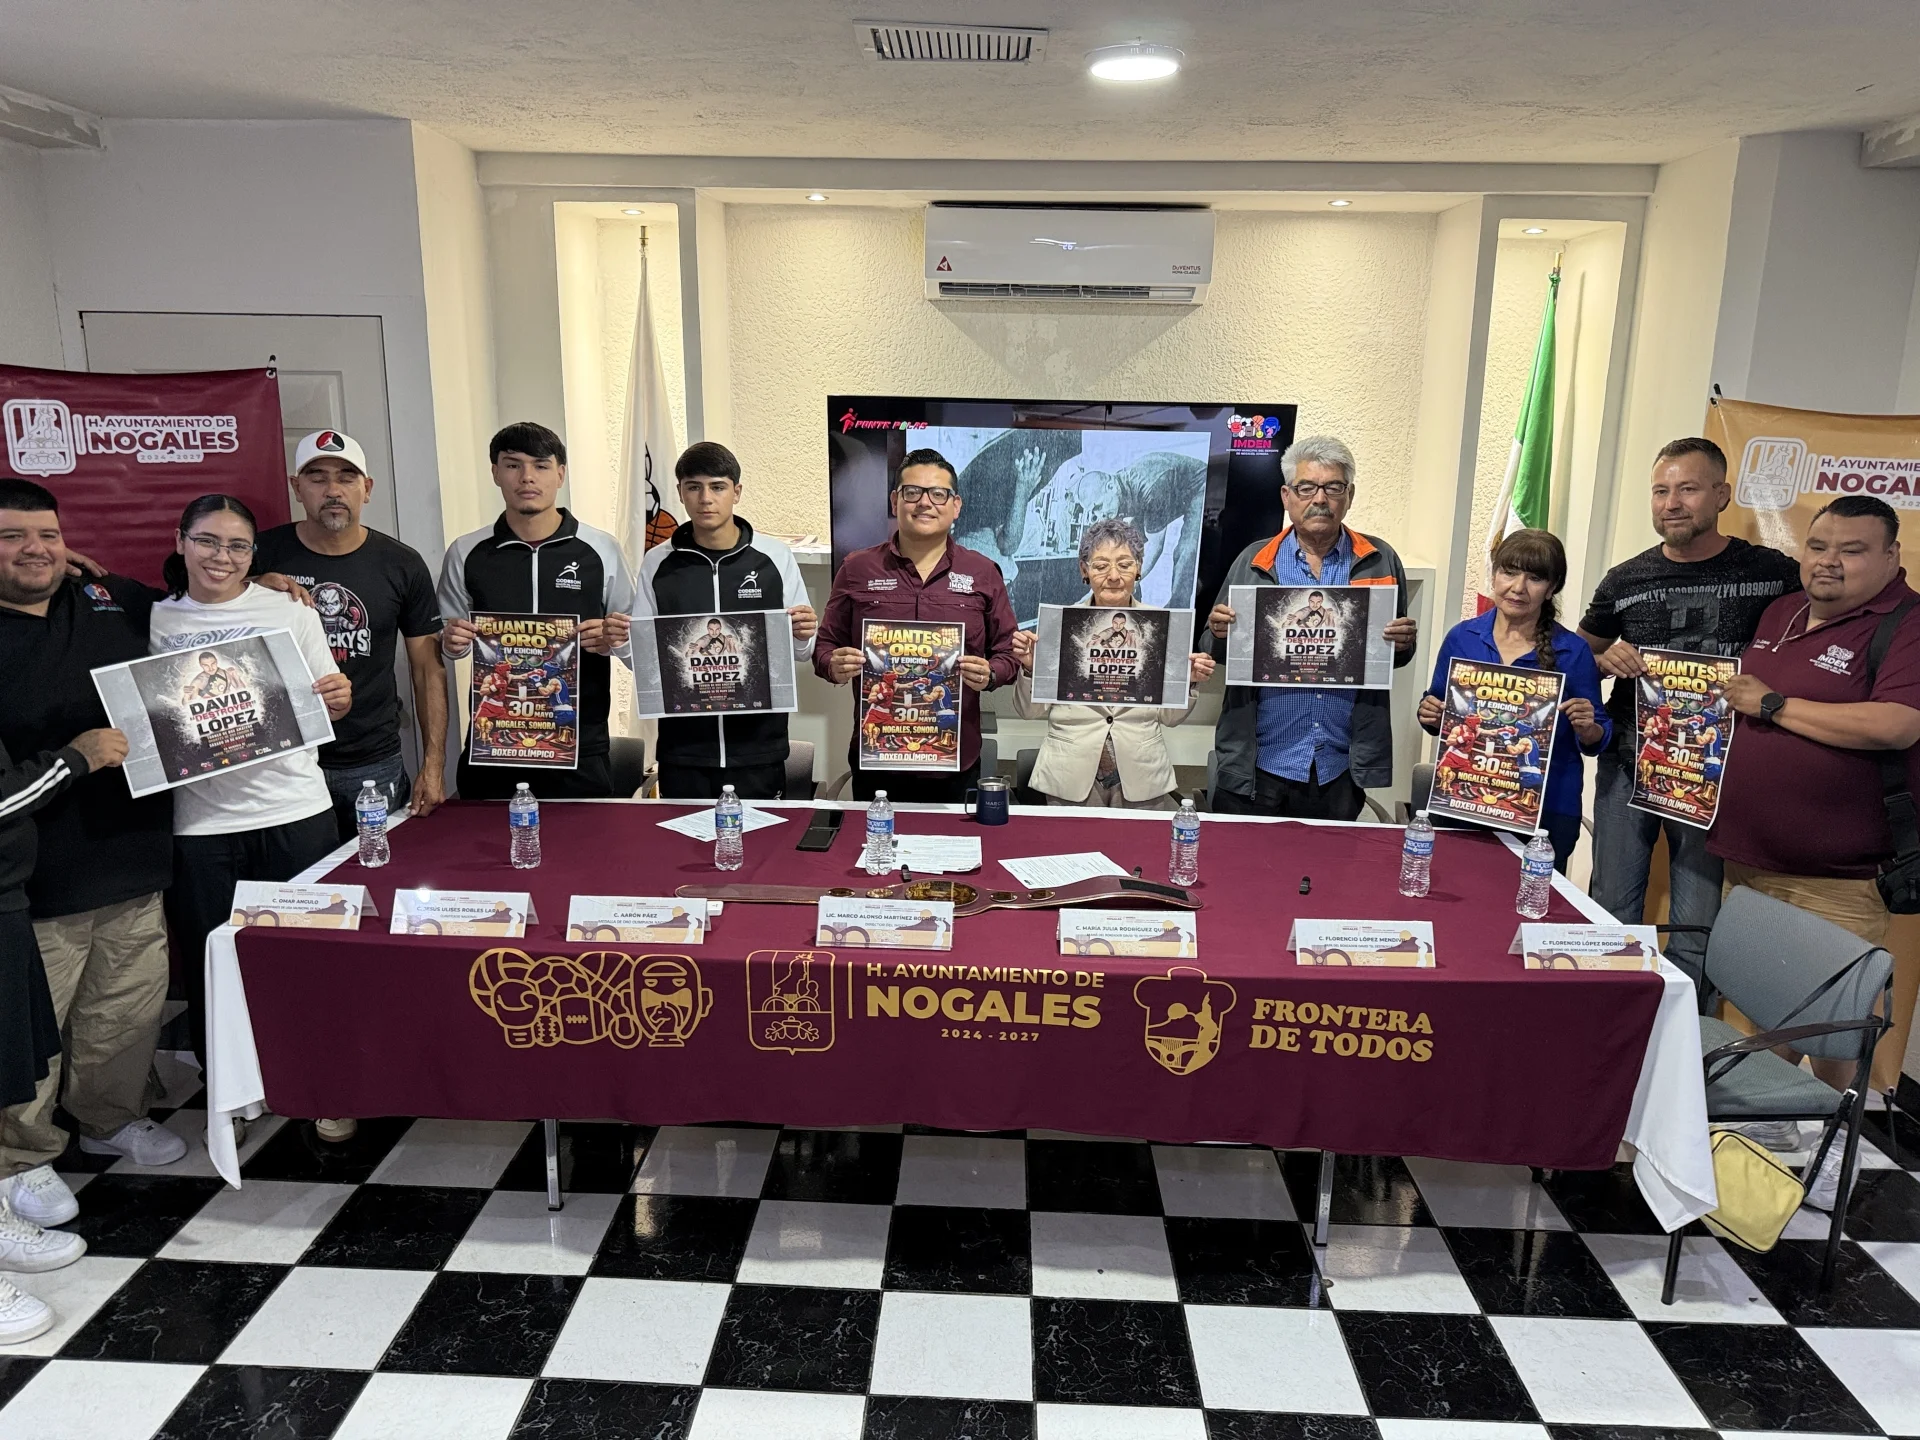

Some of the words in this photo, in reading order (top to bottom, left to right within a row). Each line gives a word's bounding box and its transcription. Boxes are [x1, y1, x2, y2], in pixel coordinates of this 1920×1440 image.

[88, 418, 102, 427] H.
[106, 418, 212, 428] AYUNTAMIENTO
[216, 419, 234, 428] DE
[90, 431, 236, 451] NOGALES
[1234, 439, 1272, 448] IMDEN
[1821, 458, 1834, 467] H.
[482, 621, 556, 636] GUANTES
[557, 628, 568, 637] DE
[1286, 629, 1336, 638] DAVID
[501, 634, 547, 648] ORO
[872, 629, 942, 647] GUANTES
[942, 637, 953, 646] DE
[514, 647, 543, 656] EDICIÓN
[889, 644, 932, 657] ORO
[1090, 649, 1137, 658] DAVID
[690, 656, 739, 666] DAVID
[1817, 654, 1849, 670] IMDEN
[1648, 660, 1717, 682] GUANTES
[1718, 672, 1728, 683] DE
[1459, 671, 1537, 694] GUANTES
[1538, 686, 1550, 697] DE
[1663, 676, 1707, 693] ORO
[189, 691, 251, 715] DAVID
[1476, 686, 1524, 705] ORO
[509, 701, 534, 717] 30
[1487, 701, 1518, 713] EDICIÓN
[894, 708, 918, 722] 30
[495, 720, 528, 730] NOGALES,
[529, 721, 556, 730] SONORA
[882, 726, 912, 734] NOGALES,
[913, 726, 938, 734] SONORA
[491, 748, 517, 757] BOXEO
[518, 748, 554, 758] OLÍMPICO
[879, 753, 902, 761] BOXEO
[904, 752, 937, 761] OLÍMPICO
[1667, 747, 1689, 767] 30
[1472, 755, 1499, 774] 30
[1688, 761, 1704, 771] MAYO
[1458, 772, 1490, 786] NOGALES,
[1491, 778, 1520, 791] SONORA
[1499, 770, 1519, 779] MAYO
[1681, 770, 1704, 784] SONORA
[1450, 799, 1476, 812] BOXEO
[1477, 804, 1515, 820] OLÍMPICO
[1647, 794, 1667, 806] BOXEO
[1668, 799, 1697, 814] OLÍMPICO
[866, 963, 888, 977] H.
[893, 964, 1068, 987] AYUNTAMIENTO
[1075, 971, 1105, 988] DE
[866, 985, 1102, 1029] NOGALES
[1252, 998, 1434, 1034] FRONTERA
[941, 1028, 982, 1040] 2024
[999, 1031, 1040, 1041] 2027
[1249, 1024, 1301, 1052] DE
[1308, 1030, 1434, 1063] TODOS
